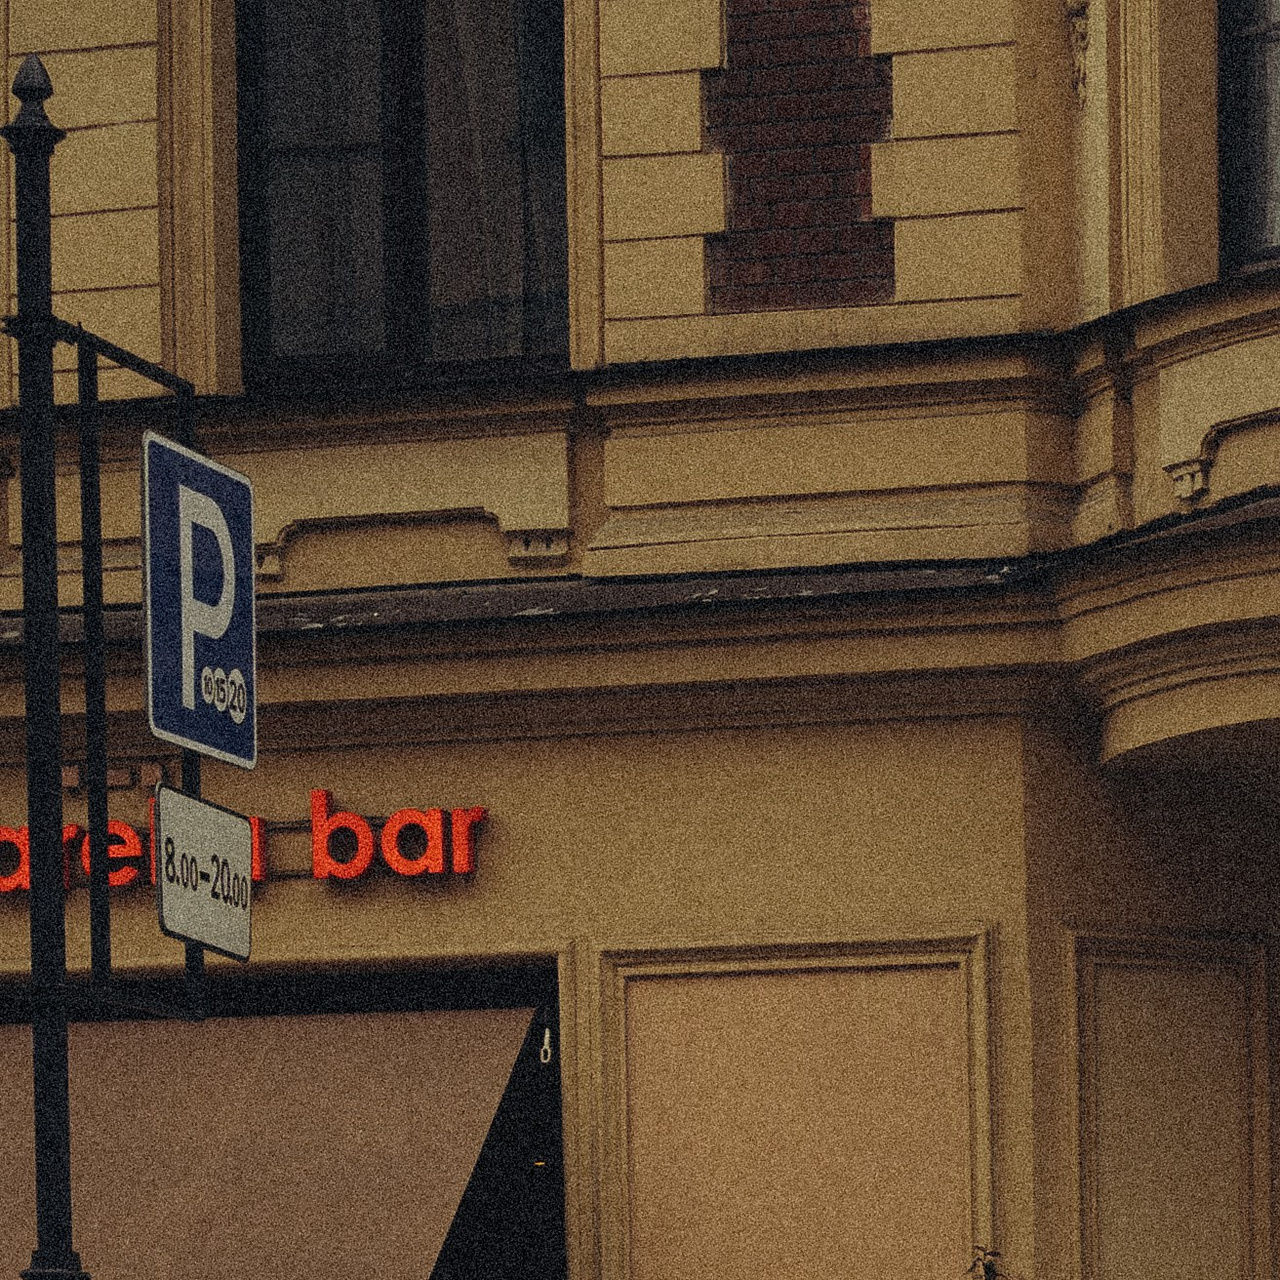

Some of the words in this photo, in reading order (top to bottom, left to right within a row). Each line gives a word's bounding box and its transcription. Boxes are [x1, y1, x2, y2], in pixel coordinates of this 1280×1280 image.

[178, 484, 237, 710] P
[229, 679, 246, 714] 20
[311, 789, 488, 880] bar
